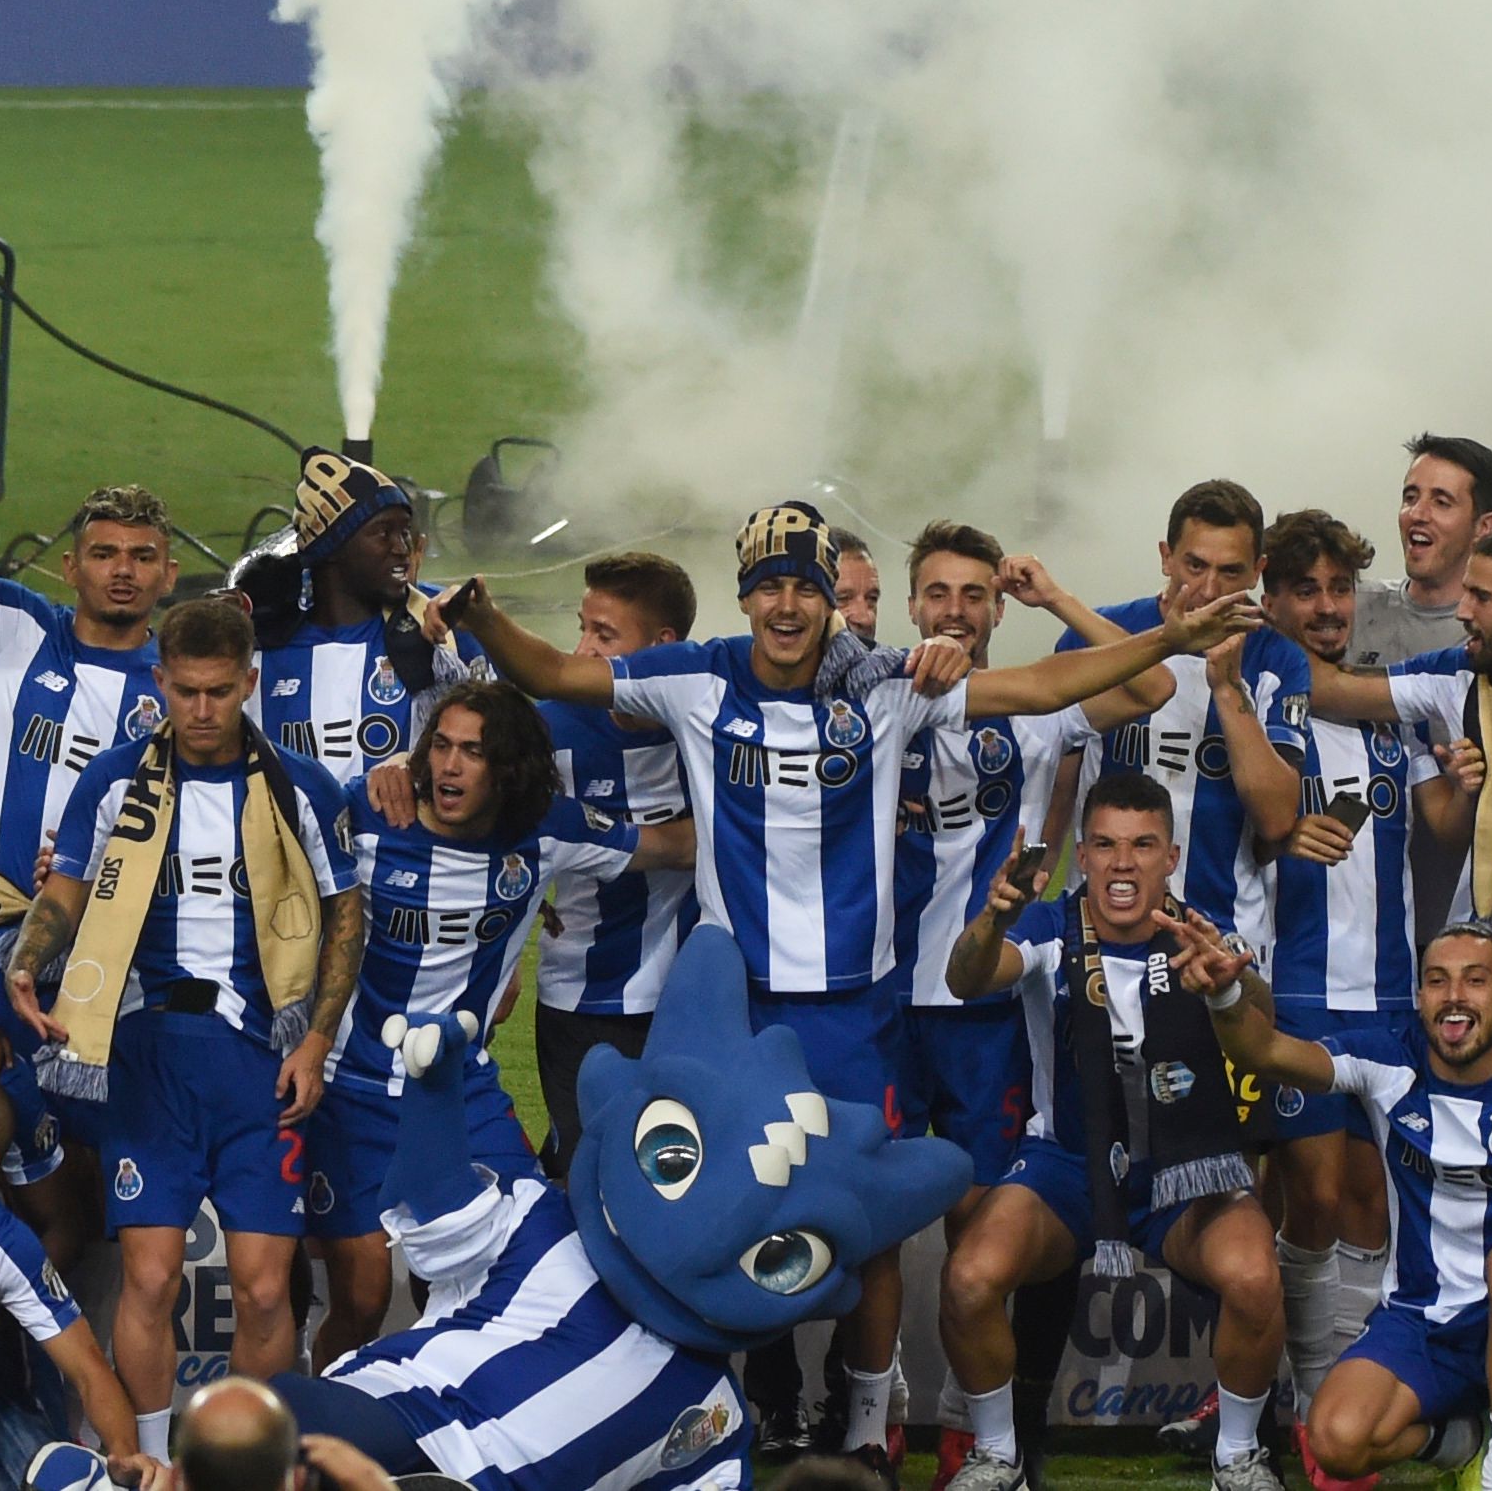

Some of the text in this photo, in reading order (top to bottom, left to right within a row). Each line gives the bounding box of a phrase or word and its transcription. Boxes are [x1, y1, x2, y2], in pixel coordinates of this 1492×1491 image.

[19, 713, 101, 774] ME
[388, 908, 515, 946] MEO
[1148, 951, 1171, 996] 2019
[1069, 1271, 1222, 1358] COM
